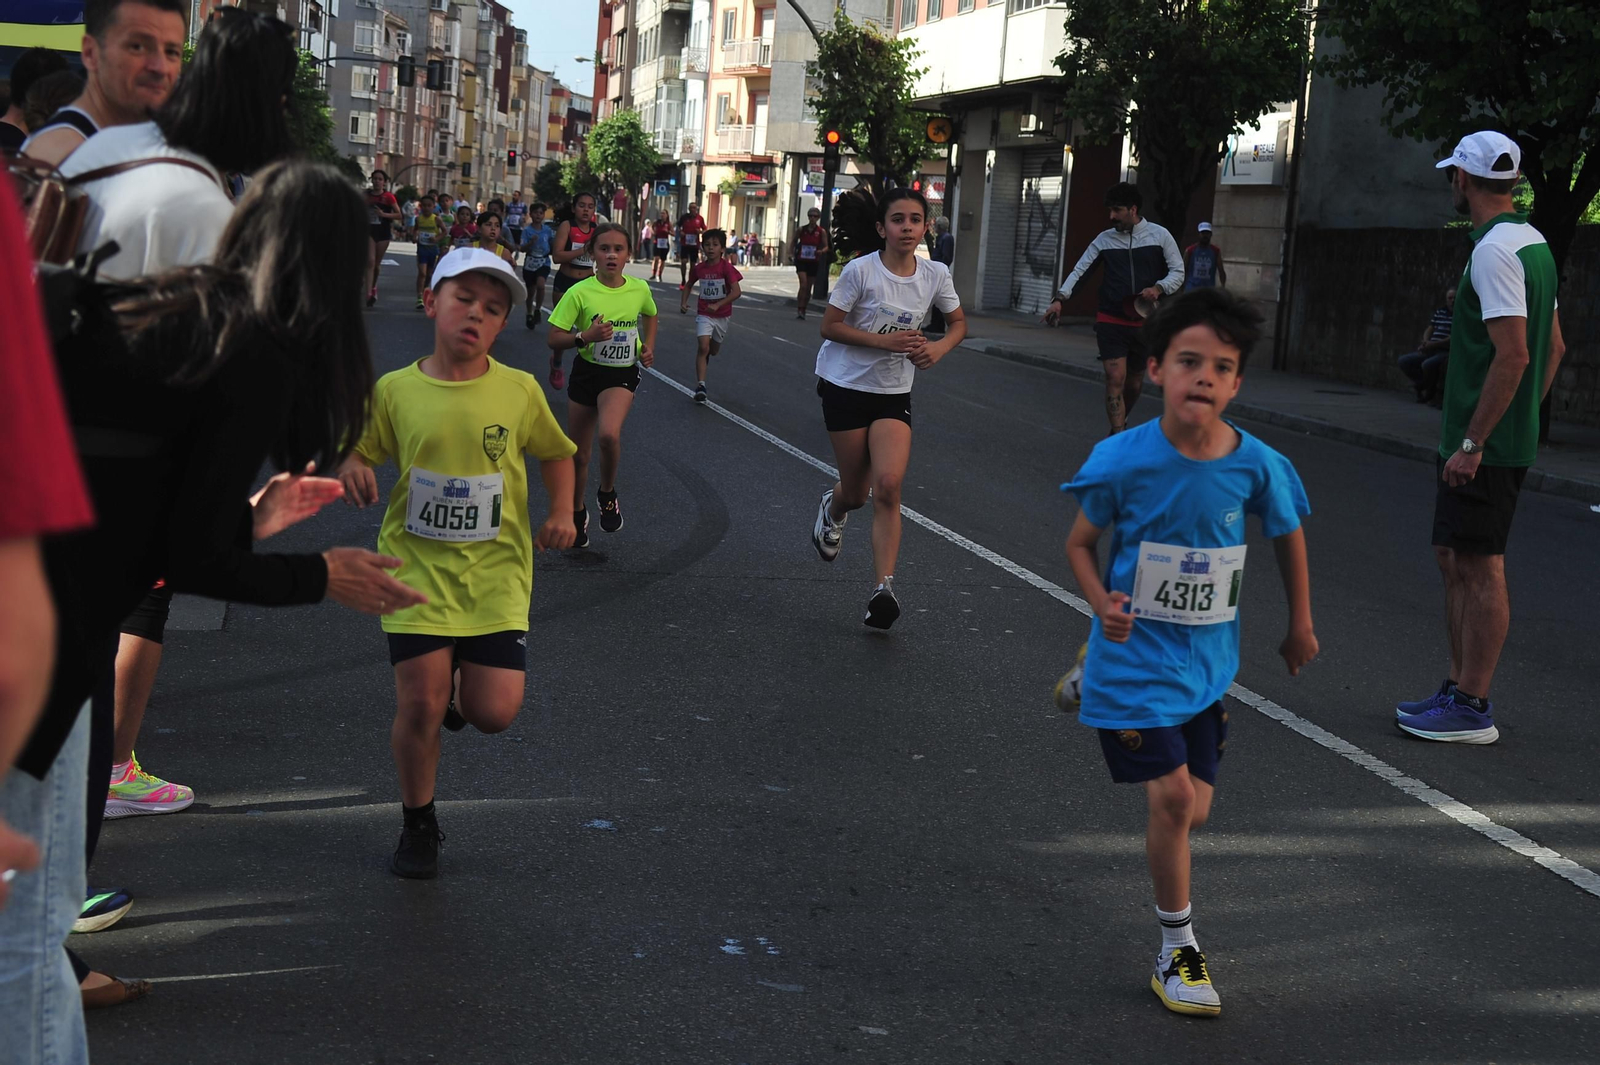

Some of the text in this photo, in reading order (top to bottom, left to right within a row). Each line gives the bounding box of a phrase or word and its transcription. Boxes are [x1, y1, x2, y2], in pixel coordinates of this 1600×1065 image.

[1260, 144, 1275, 153] REALE
[703, 288, 719, 296] 4047
[600, 345, 631, 360] 4209
[416, 477, 436, 488] 2026
[433, 496, 453, 505] RUBÉN
[419, 501, 479, 530] 4059
[1147, 553, 1172, 563] 2026
[1154, 580, 1214, 611] 4313
